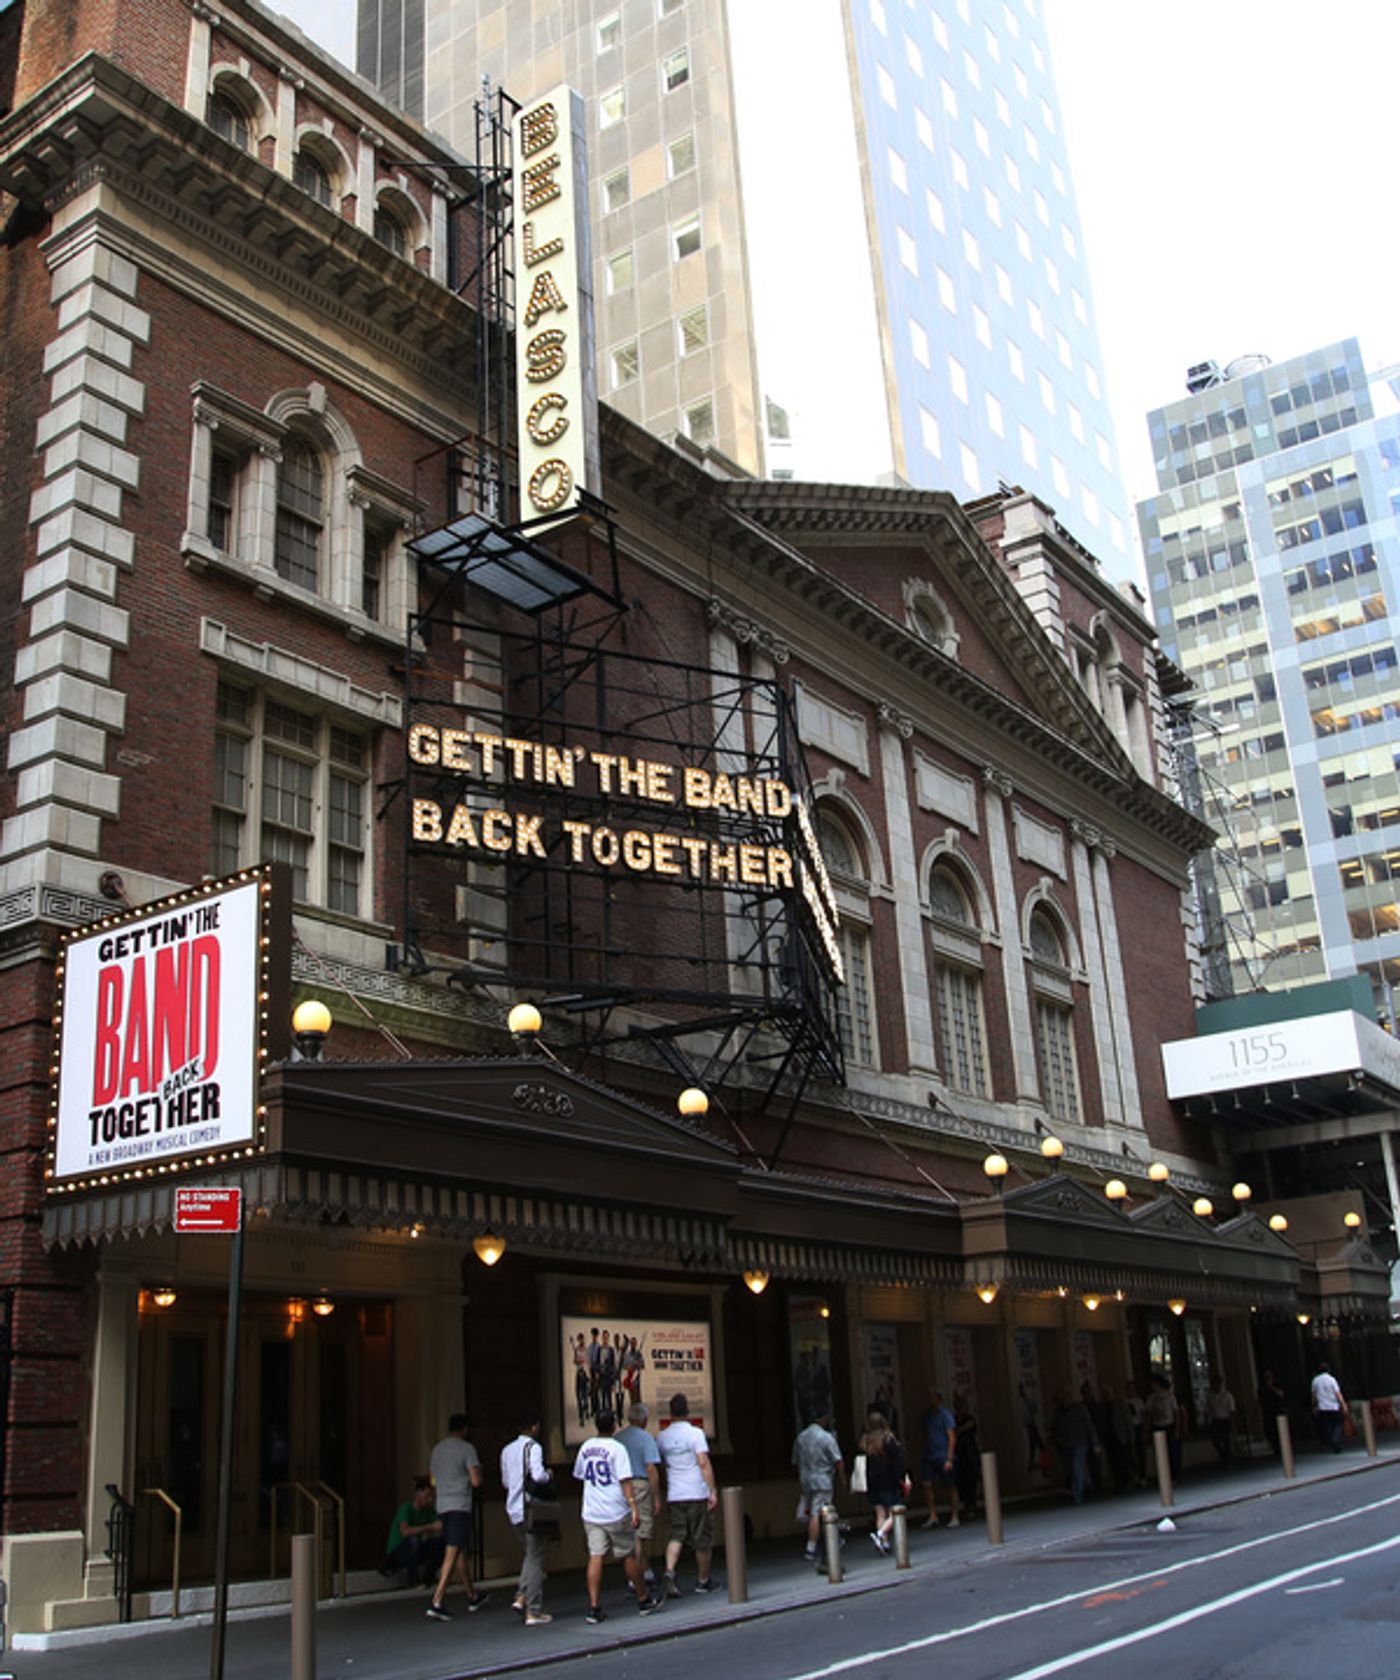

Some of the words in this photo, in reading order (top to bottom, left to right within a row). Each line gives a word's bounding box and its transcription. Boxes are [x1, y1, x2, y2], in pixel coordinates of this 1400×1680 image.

[521, 102, 573, 512] BELASCO
[407, 724, 585, 788] GETTIN'
[591, 752, 674, 803] THE
[684, 766, 792, 818] BAND
[412, 798, 547, 859] BACK
[563, 820, 795, 889] TOGETHER
[99, 912, 193, 962] GETTIN'
[196, 902, 221, 934] THE
[92, 934, 221, 1107] BAND
[1229, 1031, 1287, 1068] 1155
[163, 1059, 199, 1100] BACK
[89, 1082, 220, 1146] TOGETHER
[95, 1150, 111, 1164] NEW
[112, 1141, 153, 1161] BROADWAY
[156, 1132, 188, 1152] MUSICAL
[189, 1125, 220, 1145] COMEDY
[180, 1192, 190, 1202] NO
[193, 1192, 230, 1202] STANDING
[585, 1460, 611, 1487] 49
